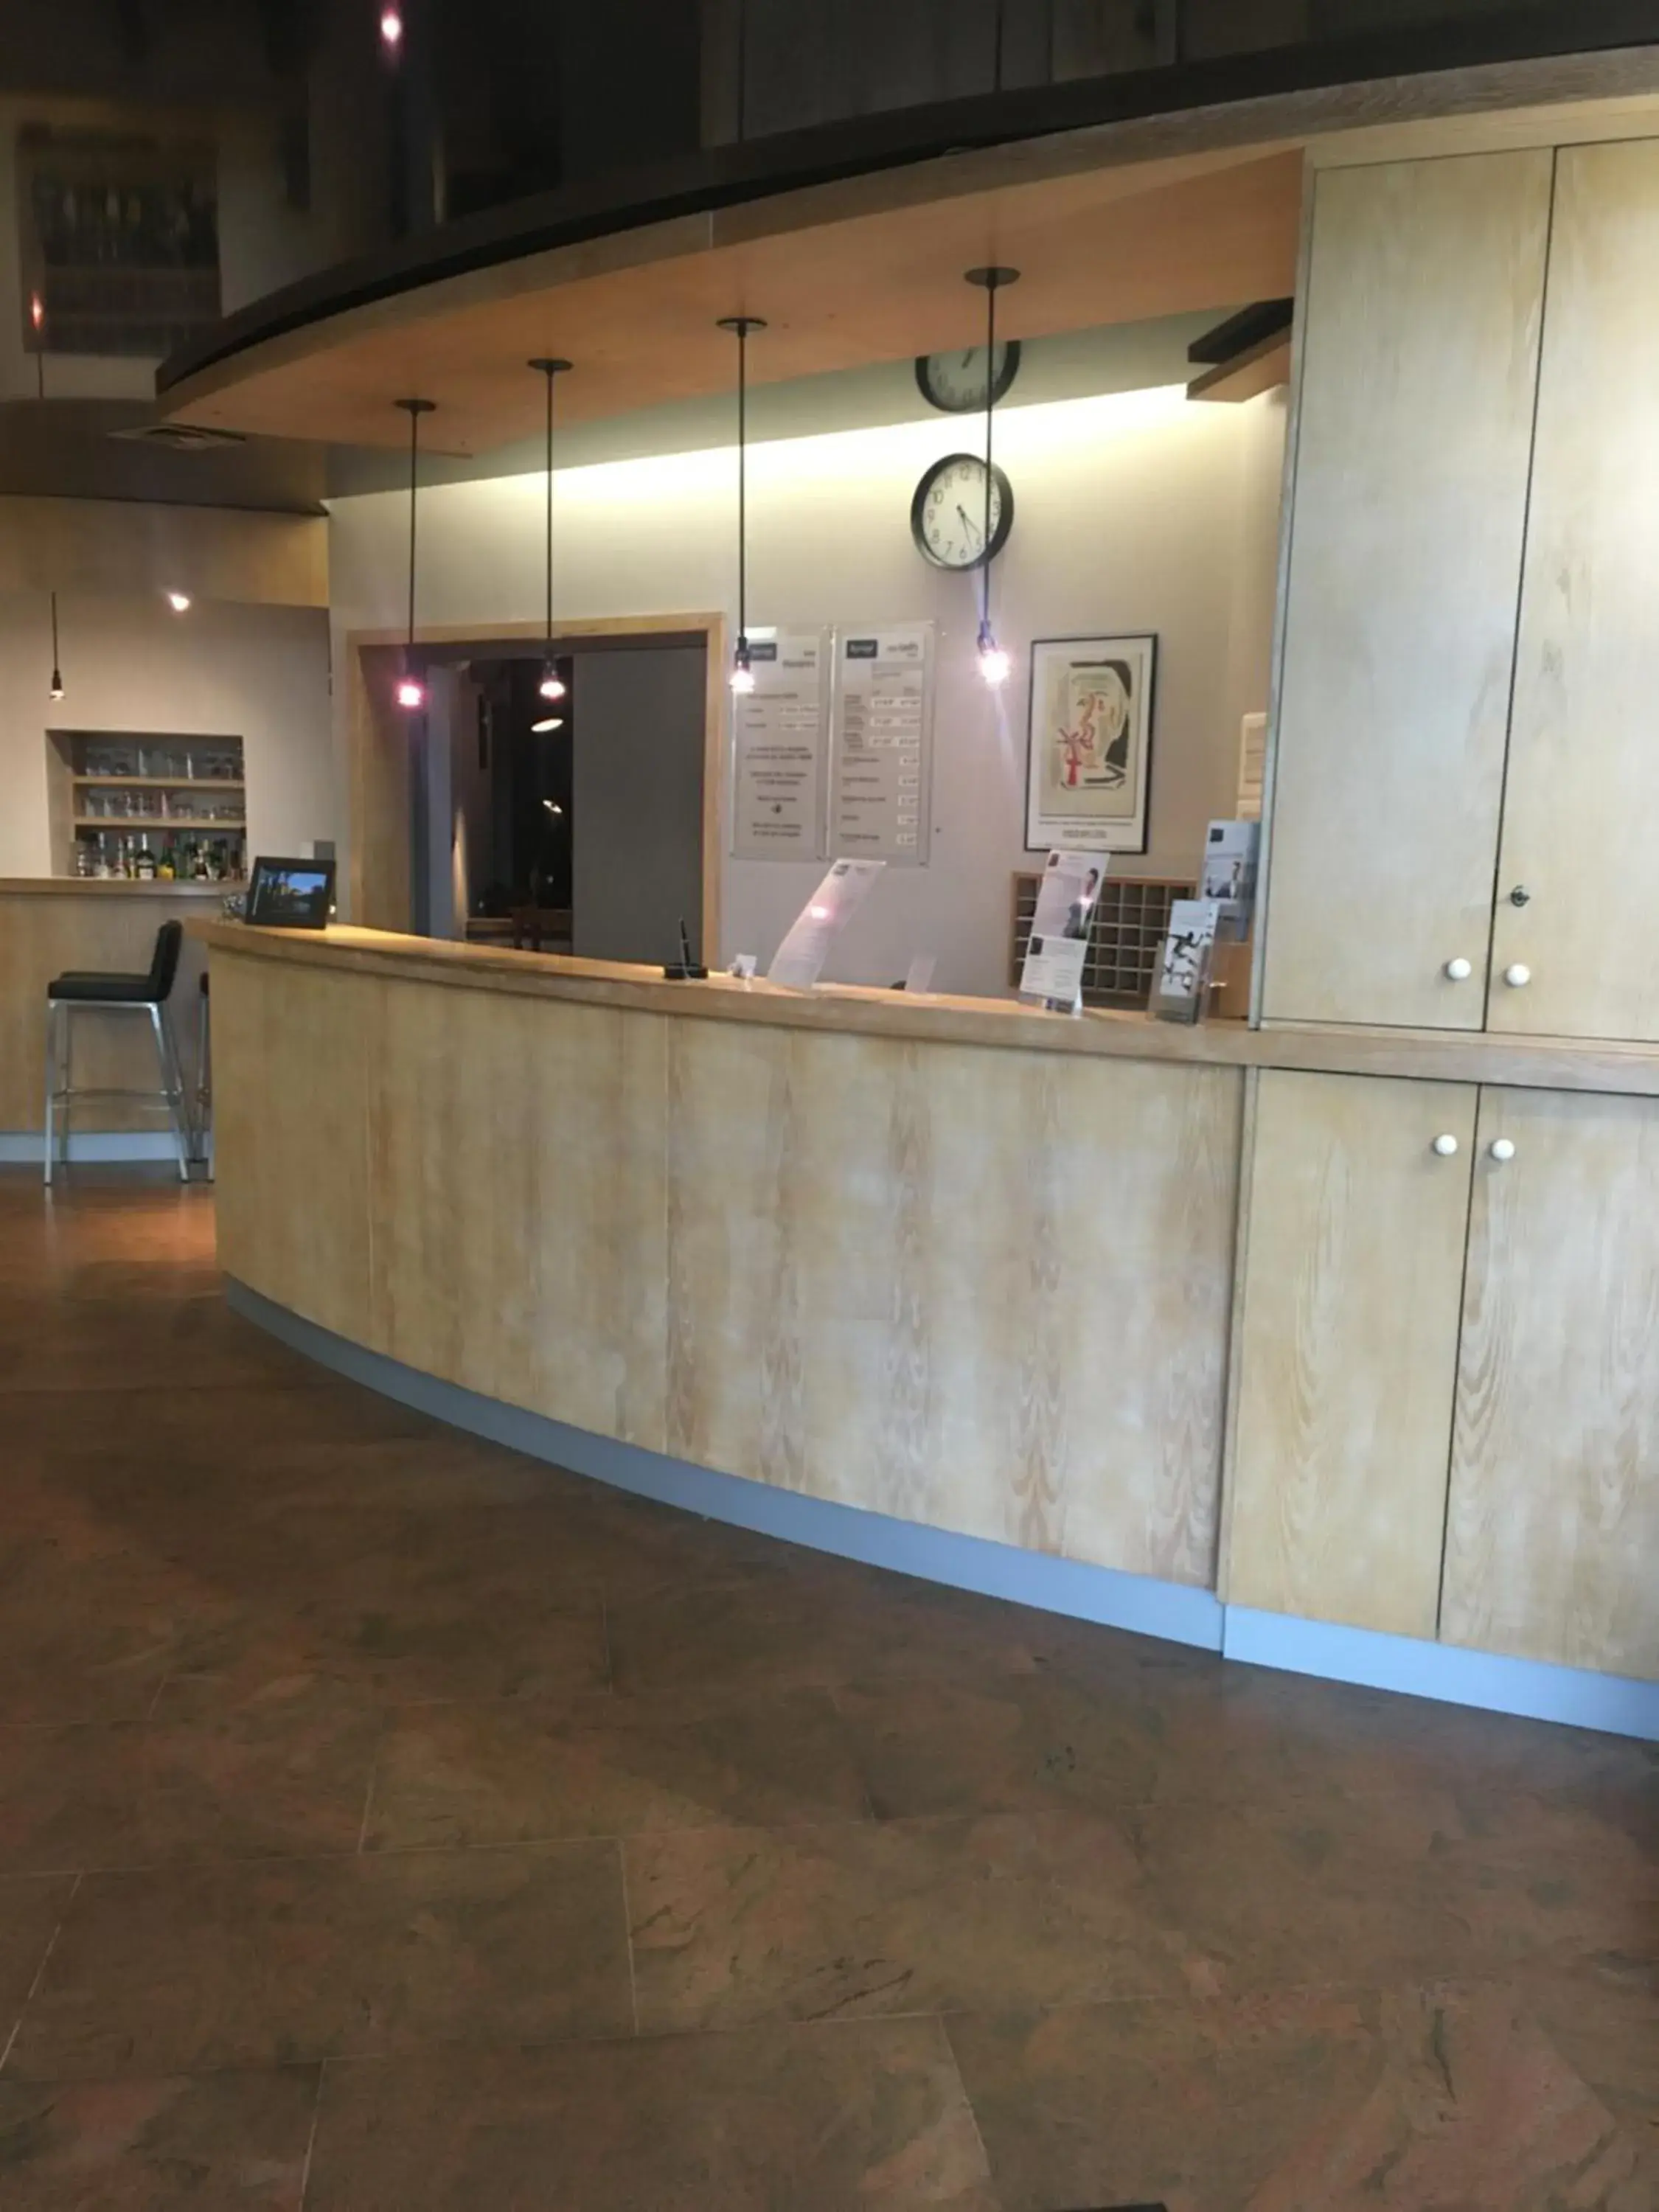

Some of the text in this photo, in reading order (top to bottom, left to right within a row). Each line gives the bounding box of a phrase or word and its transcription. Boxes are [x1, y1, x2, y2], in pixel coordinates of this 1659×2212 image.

[931, 490, 944, 505] 10
[927, 508, 936, 524] 9
[931, 529, 940, 544] 8
[943, 540, 954, 559] 7
[959, 544, 968, 560] 6
